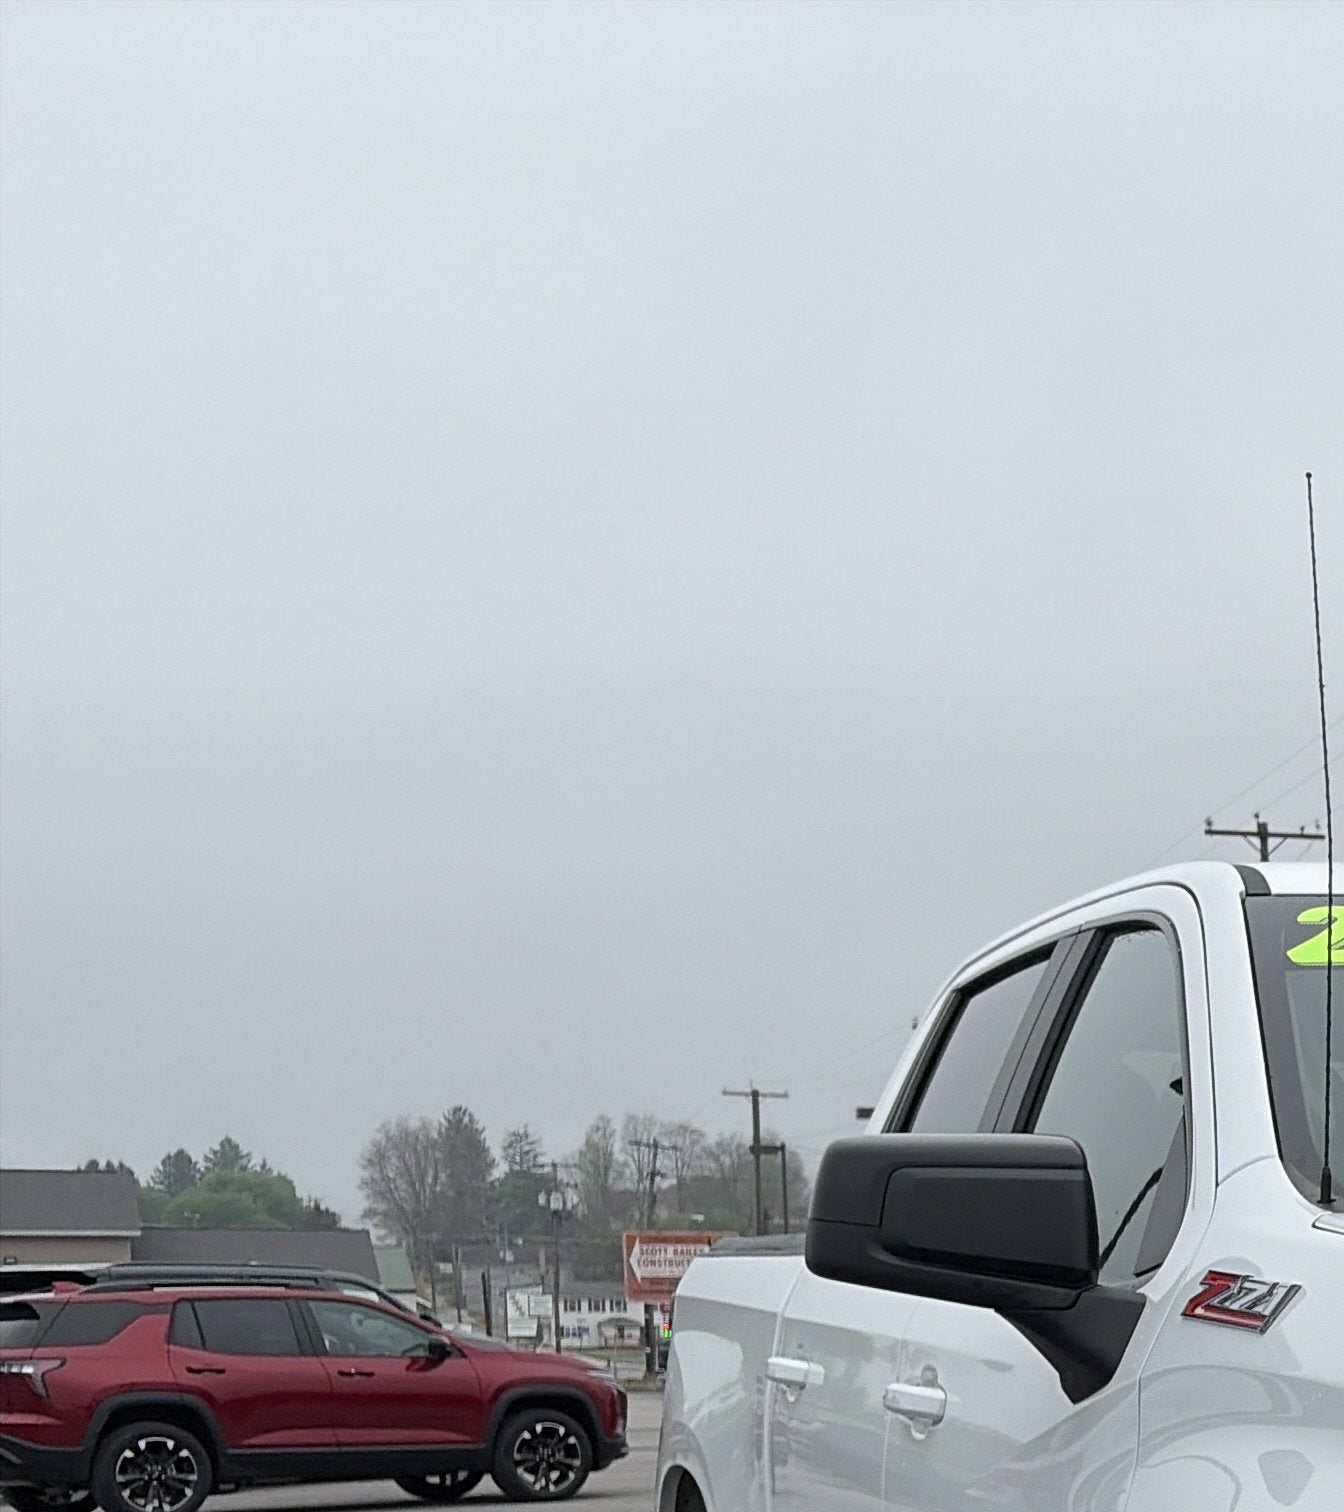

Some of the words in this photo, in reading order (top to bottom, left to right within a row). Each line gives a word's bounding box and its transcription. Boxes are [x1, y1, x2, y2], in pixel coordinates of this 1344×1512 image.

[639, 1246, 668, 1257] SCOTT
[636, 1258, 693, 1269] CONSTRUCT
[1181, 1269, 1302, 1334] Z71
